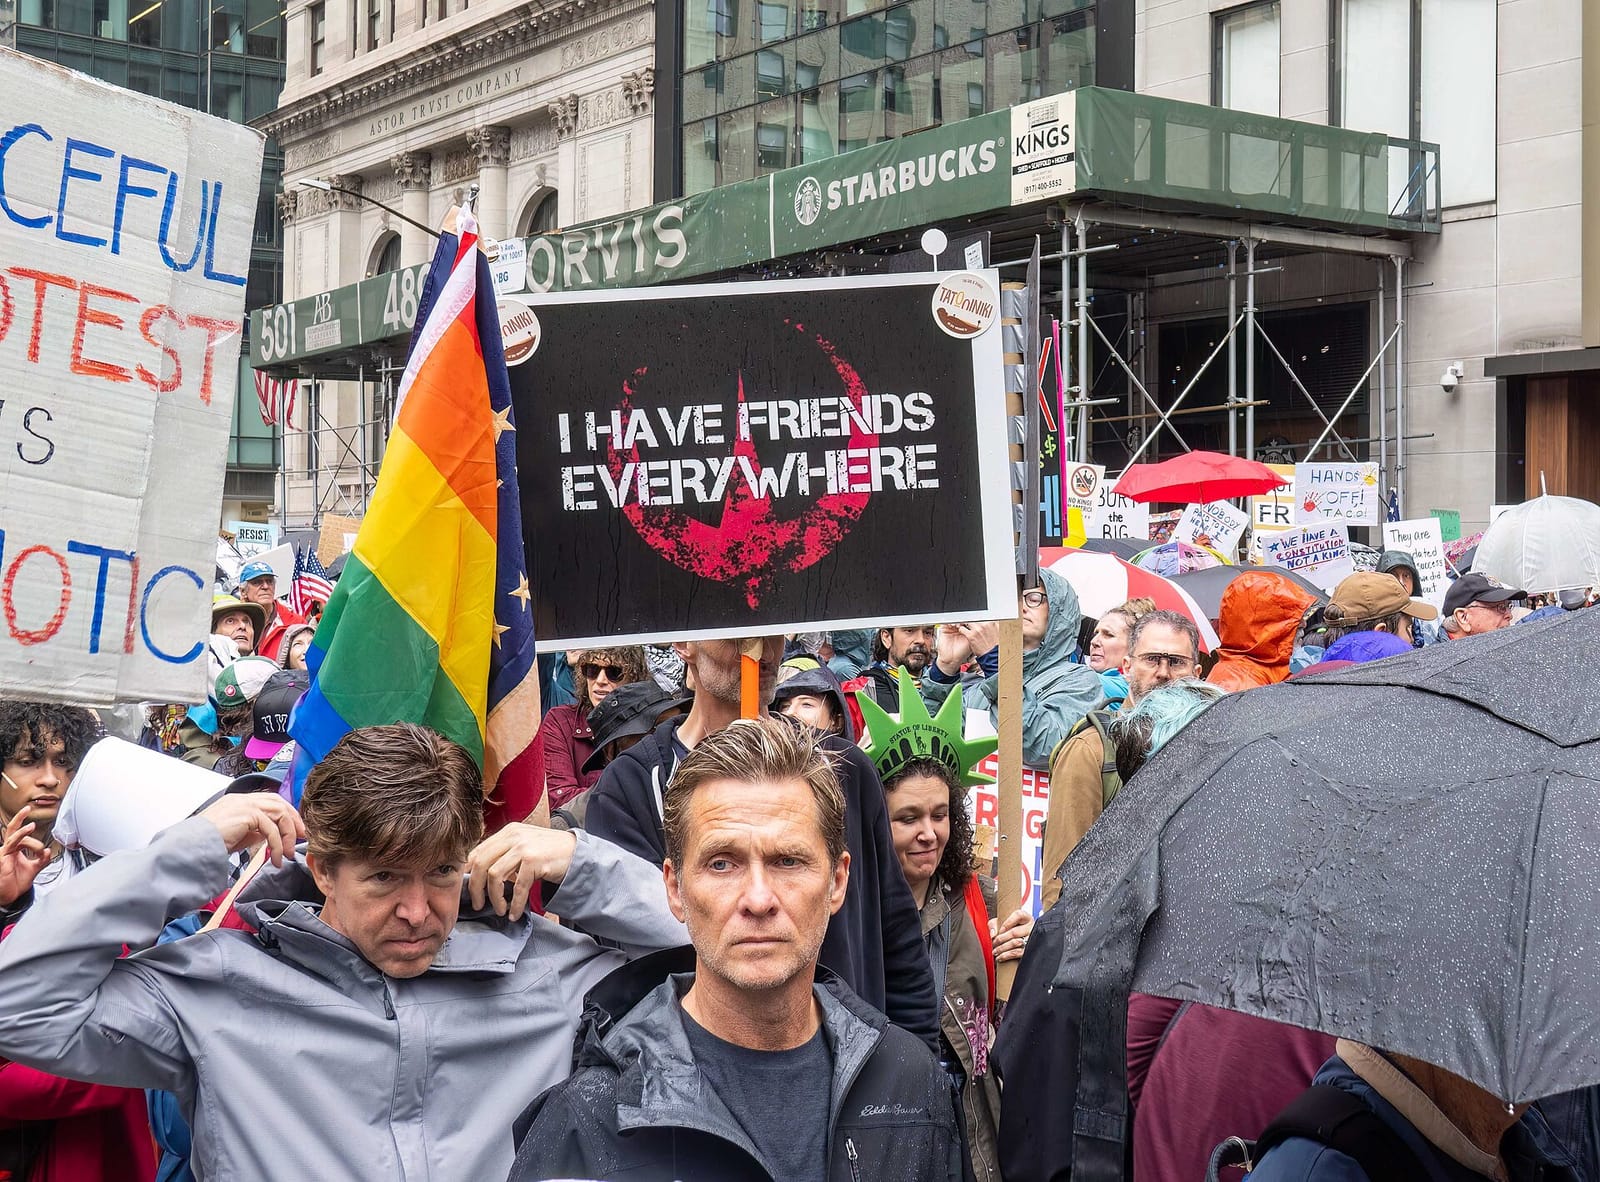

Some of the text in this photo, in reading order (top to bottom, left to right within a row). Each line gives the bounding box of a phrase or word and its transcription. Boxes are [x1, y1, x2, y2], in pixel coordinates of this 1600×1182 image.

[370, 67, 521, 136] ASTOR TRVST COMPANY
[1016, 124, 1069, 156] KINGS
[826, 139, 997, 210] STARBUCKS
[526, 205, 687, 293] ORVIS
[261, 303, 297, 361] 501
[558, 392, 936, 453] I HAVE FRIENDS
[560, 443, 940, 511] EVERYWHERE
[1311, 469, 1360, 483] HANDS
[1108, 511, 1124, 522] the
[1203, 504, 1241, 530] NOBODY
[239, 528, 269, 541] RESIST
[1103, 524, 1129, 540] BIG
[1280, 528, 1338, 549] WE HAVE A
[1389, 529, 1412, 548] They
[1414, 530, 1431, 541] are
[1276, 539, 1345, 560] CONSTITUTION
[1287, 556, 1310, 569] NOT
[1313, 554, 1319, 563] A
[890, 726, 912, 745] STATUE
[921, 724, 950, 739] LIBERTY
